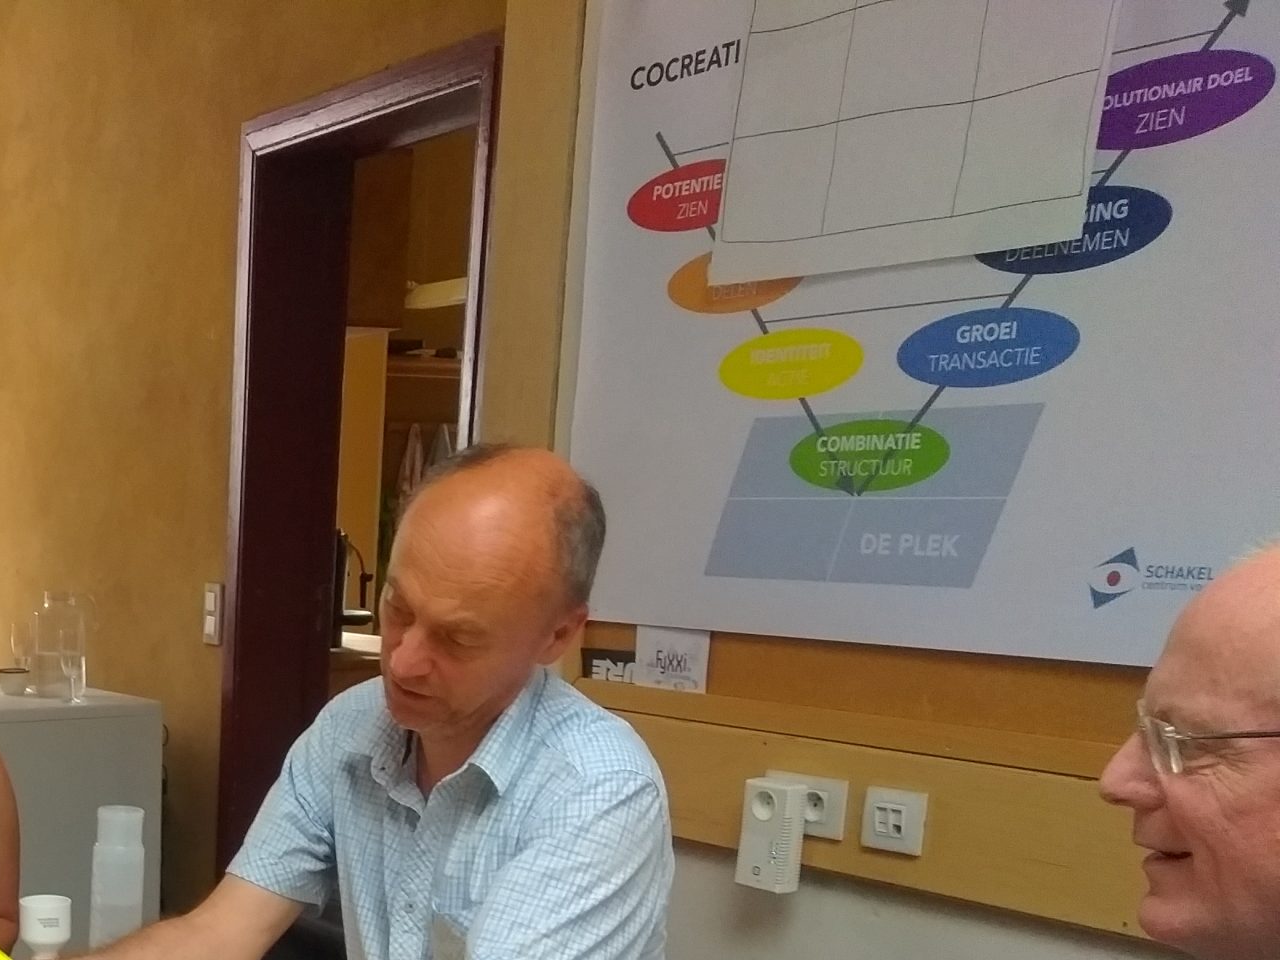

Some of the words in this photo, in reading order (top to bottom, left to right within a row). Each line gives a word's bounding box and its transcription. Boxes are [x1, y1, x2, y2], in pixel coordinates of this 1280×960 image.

[630, 39, 741, 90] COCREATI
[1207, 66, 1254, 90] DOEL
[1135, 106, 1186, 134] ZIEN
[676, 199, 709, 219] ZIEN
[1084, 199, 1129, 223] ING
[956, 321, 1017, 343] GROEI
[928, 347, 1041, 372] TRANSACTIE
[816, 433, 922, 452] COMBINATIE
[819, 459, 913, 477] STRUCTUUR
[860, 533, 892, 555] DE
[898, 534, 960, 557] PLEK
[1145, 565, 1214, 581] SCHAKEL
